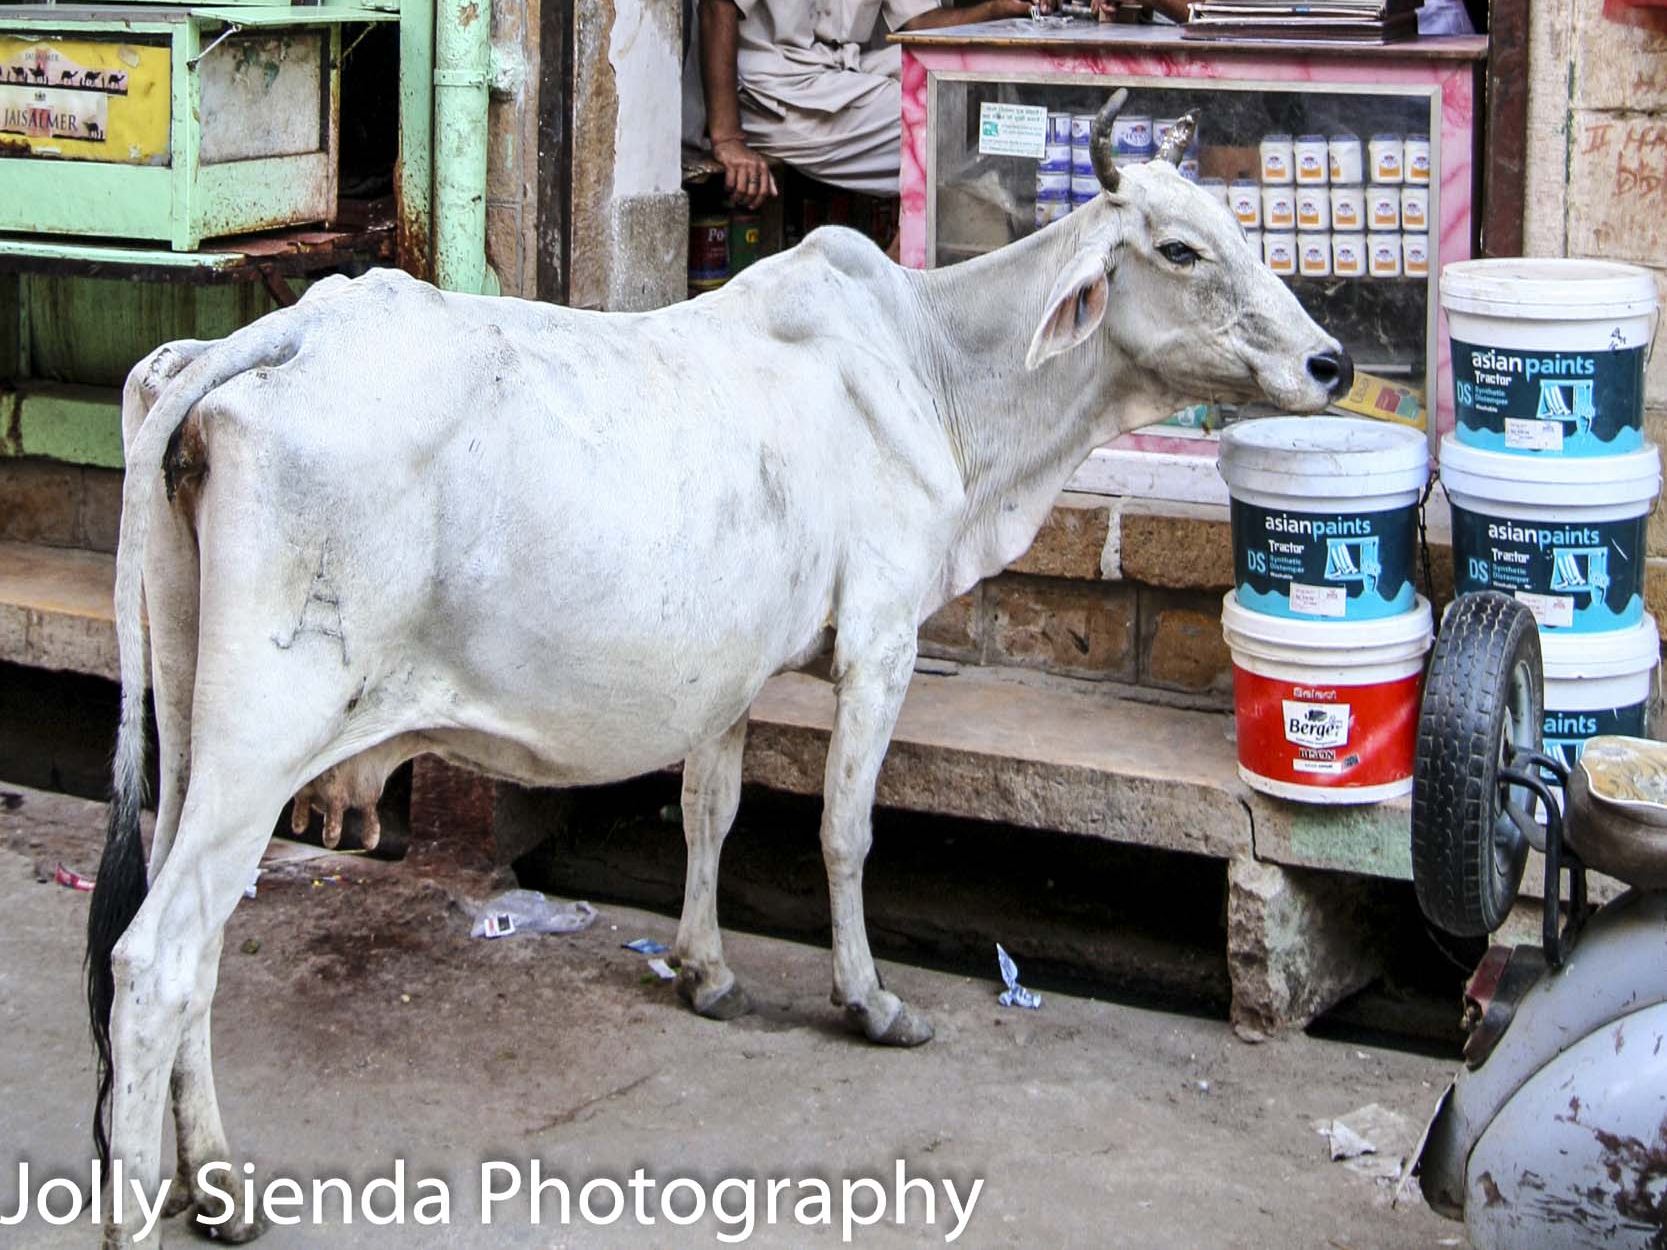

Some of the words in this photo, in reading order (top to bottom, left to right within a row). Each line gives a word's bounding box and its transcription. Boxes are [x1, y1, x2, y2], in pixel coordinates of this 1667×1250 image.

[4, 107, 80, 131] JAISALMER
[1474, 370, 1512, 386] Tractor
[1457, 381, 1473, 405] DS
[1268, 539, 1305, 555] Tractor
[1491, 548, 1530, 564] Tractor
[1248, 549, 1266, 574] DS
[1469, 557, 1489, 584] DS
[1289, 718, 1340, 738] Berger
